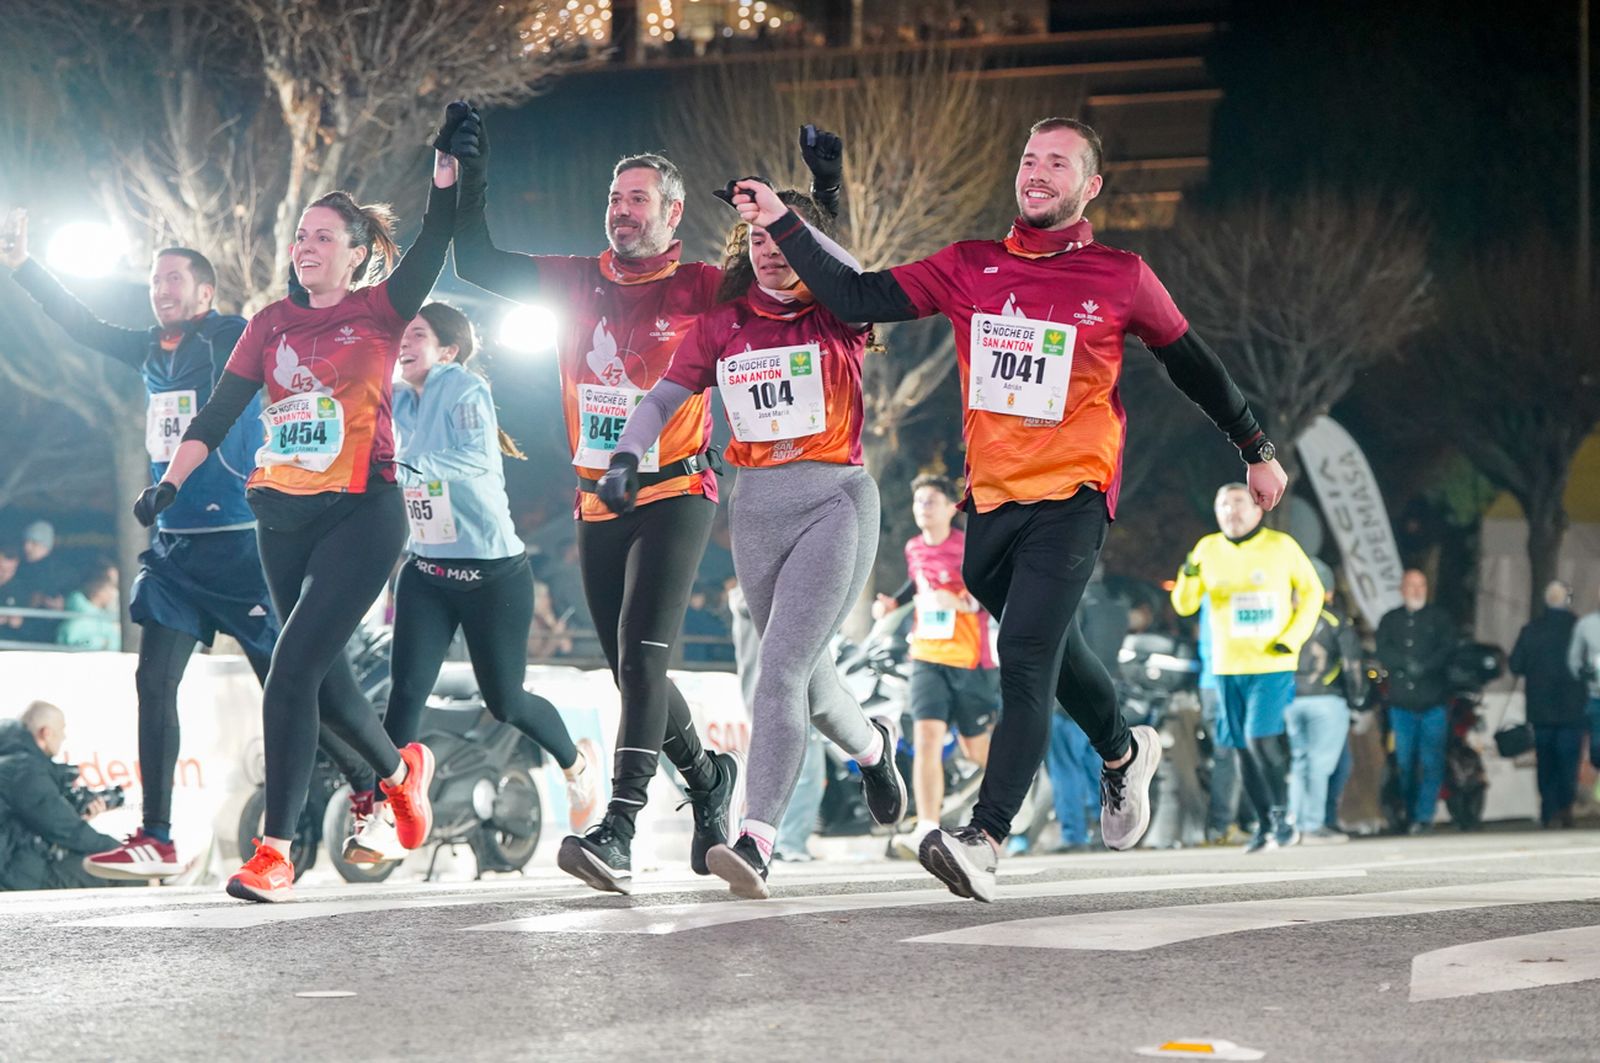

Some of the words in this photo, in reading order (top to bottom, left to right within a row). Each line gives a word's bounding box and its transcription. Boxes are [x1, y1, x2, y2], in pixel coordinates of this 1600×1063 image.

[992, 327, 1022, 338] NOCHE
[1023, 330, 1035, 340] DE
[982, 337, 999, 348] SAN
[738, 360, 767, 371] NOCHE
[769, 358, 781, 368] DE
[991, 350, 1046, 384] 7041
[602, 363, 623, 387] 43
[728, 374, 748, 385] SAN
[593, 395, 617, 405] NOCHE
[617, 396, 627, 406] DE
[748, 380, 794, 410] 104
[585, 403, 598, 413] SAN
[279, 421, 327, 448] 8454
[589, 415, 627, 442] 845
[447, 568, 480, 582] MAX
